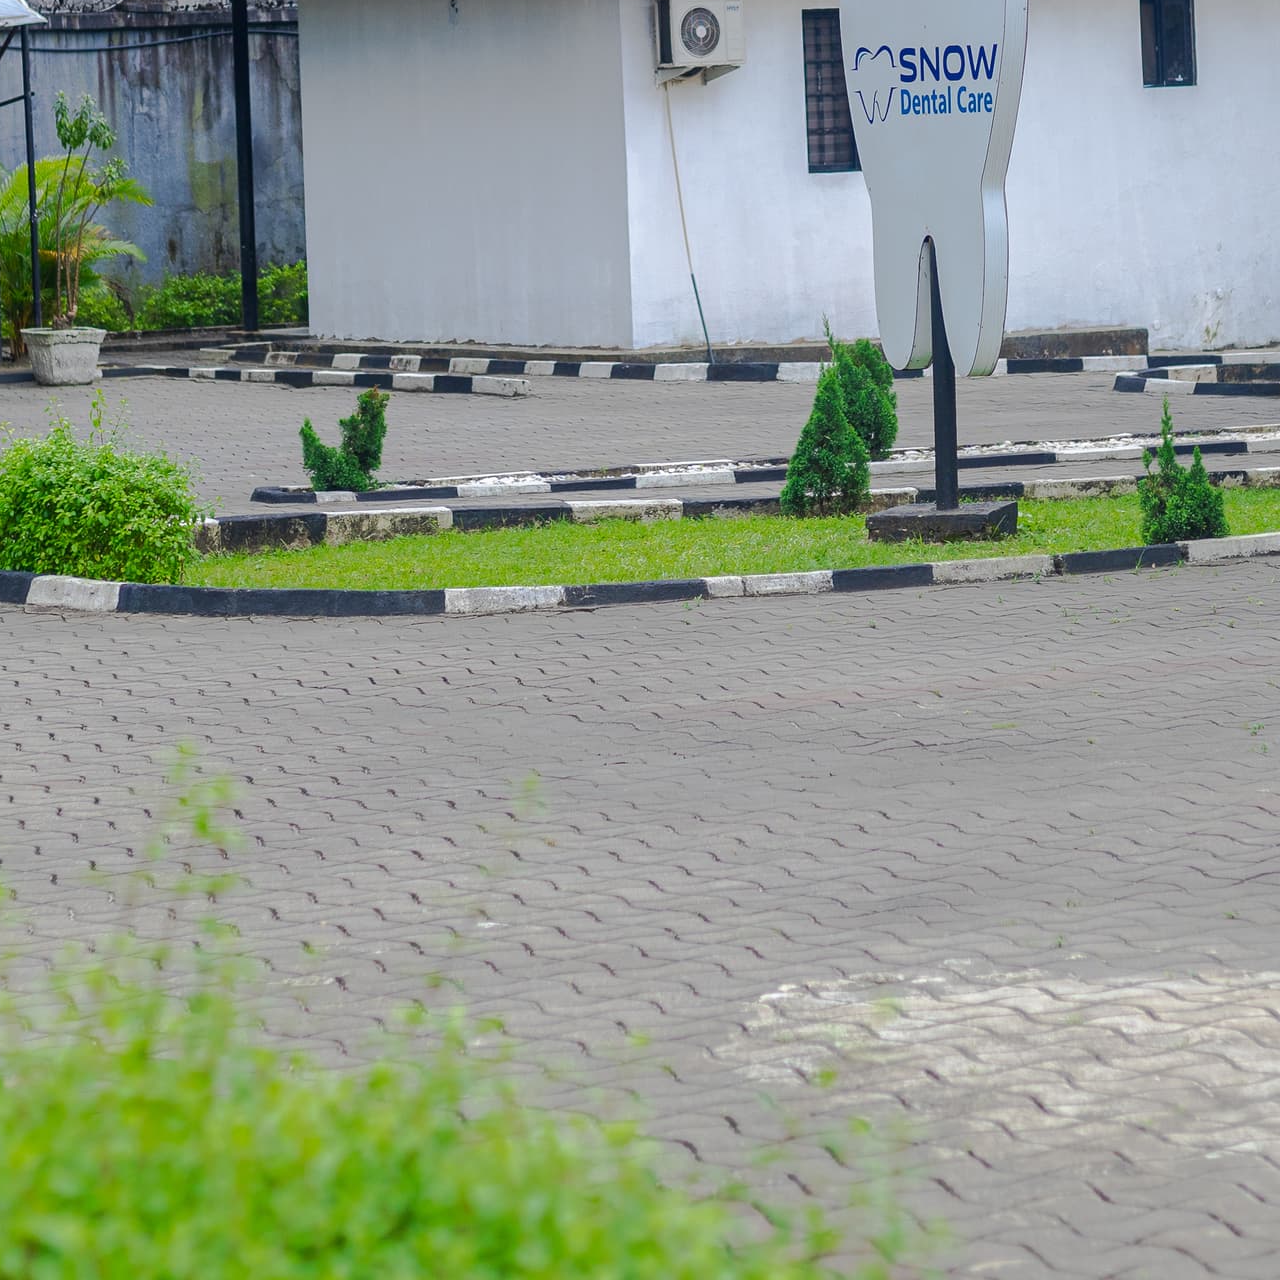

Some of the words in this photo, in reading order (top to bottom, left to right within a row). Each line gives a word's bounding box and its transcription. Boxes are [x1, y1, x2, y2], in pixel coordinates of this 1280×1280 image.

[899, 44, 998, 83] SNOW
[900, 86, 952, 116] Dental
[957, 86, 993, 114] Care
